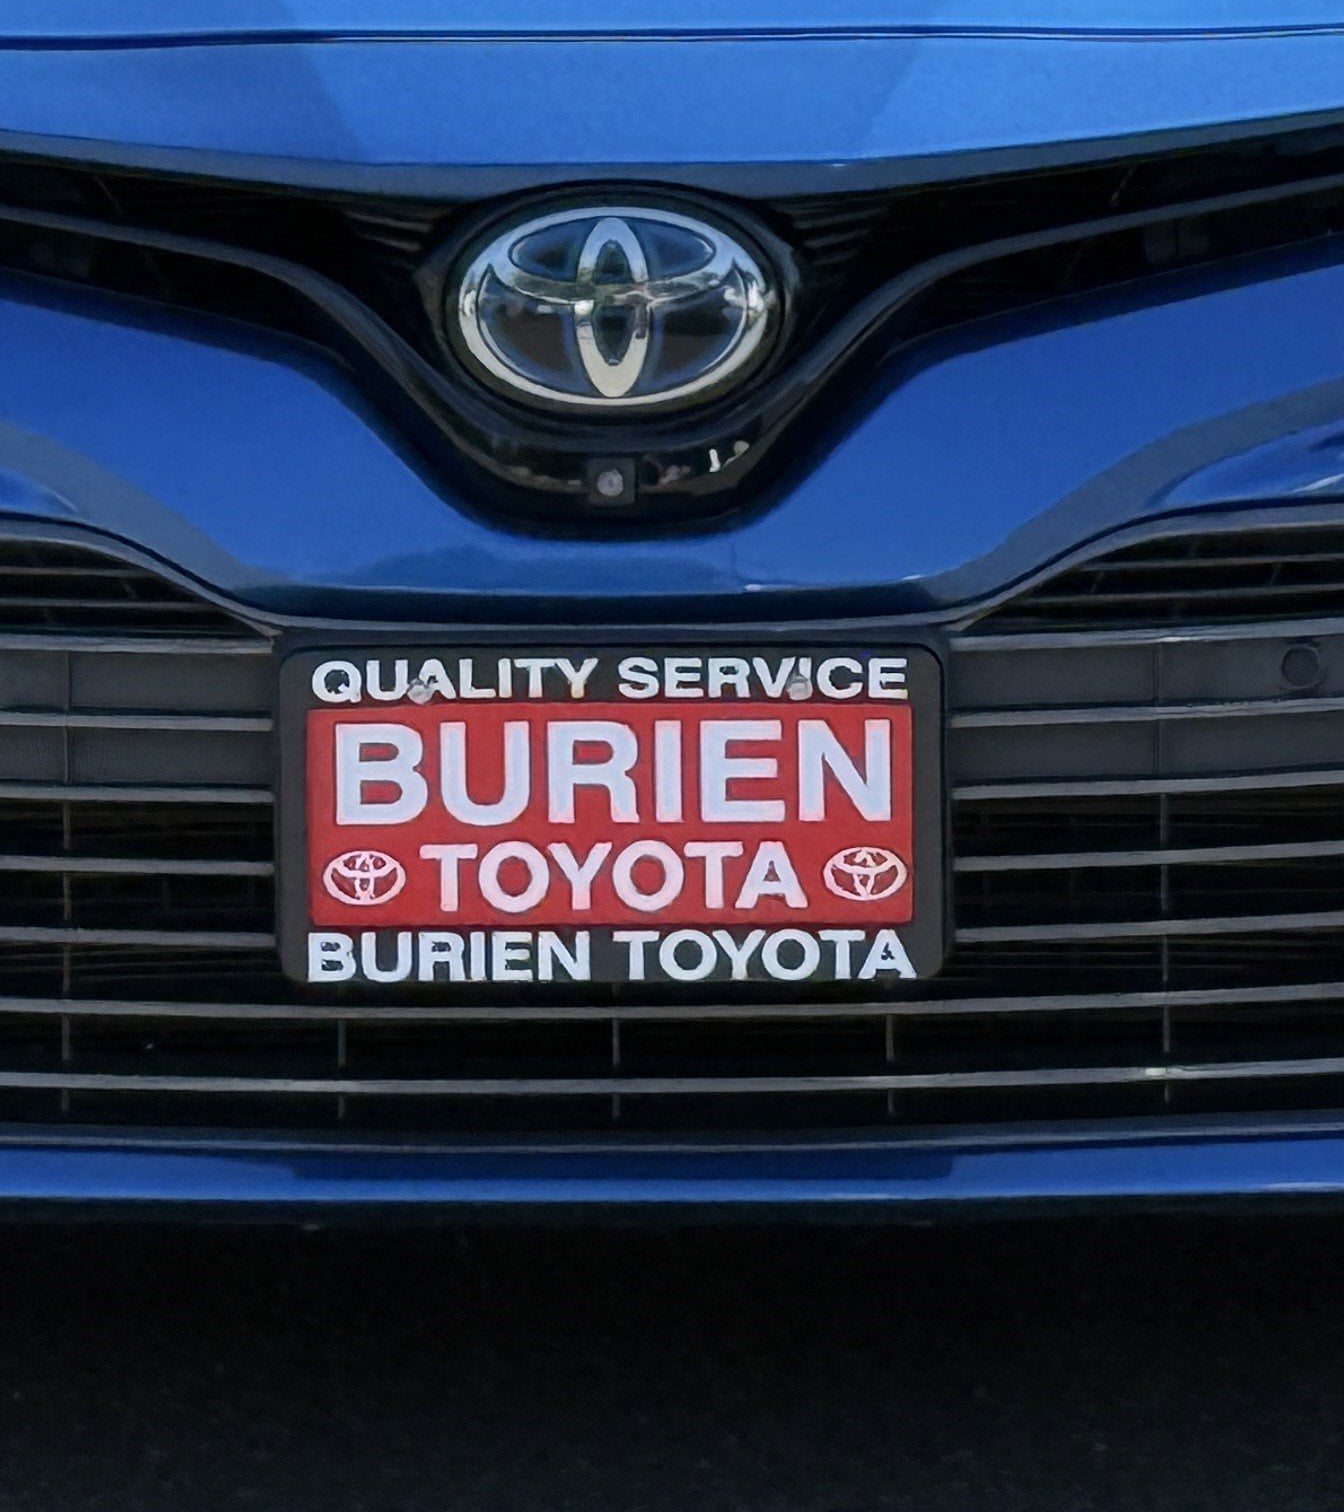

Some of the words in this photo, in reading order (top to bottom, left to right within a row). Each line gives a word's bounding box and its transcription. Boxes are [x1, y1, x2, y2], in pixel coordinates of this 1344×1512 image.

[311, 656, 599, 703] QUALITY
[617, 655, 909, 700] SERVICE
[334, 718, 892, 826] BURIEN
[419, 839, 809, 914] TOYOTA
[307, 930, 591, 982] BURIEN
[612, 928, 917, 981] TOYOTA
